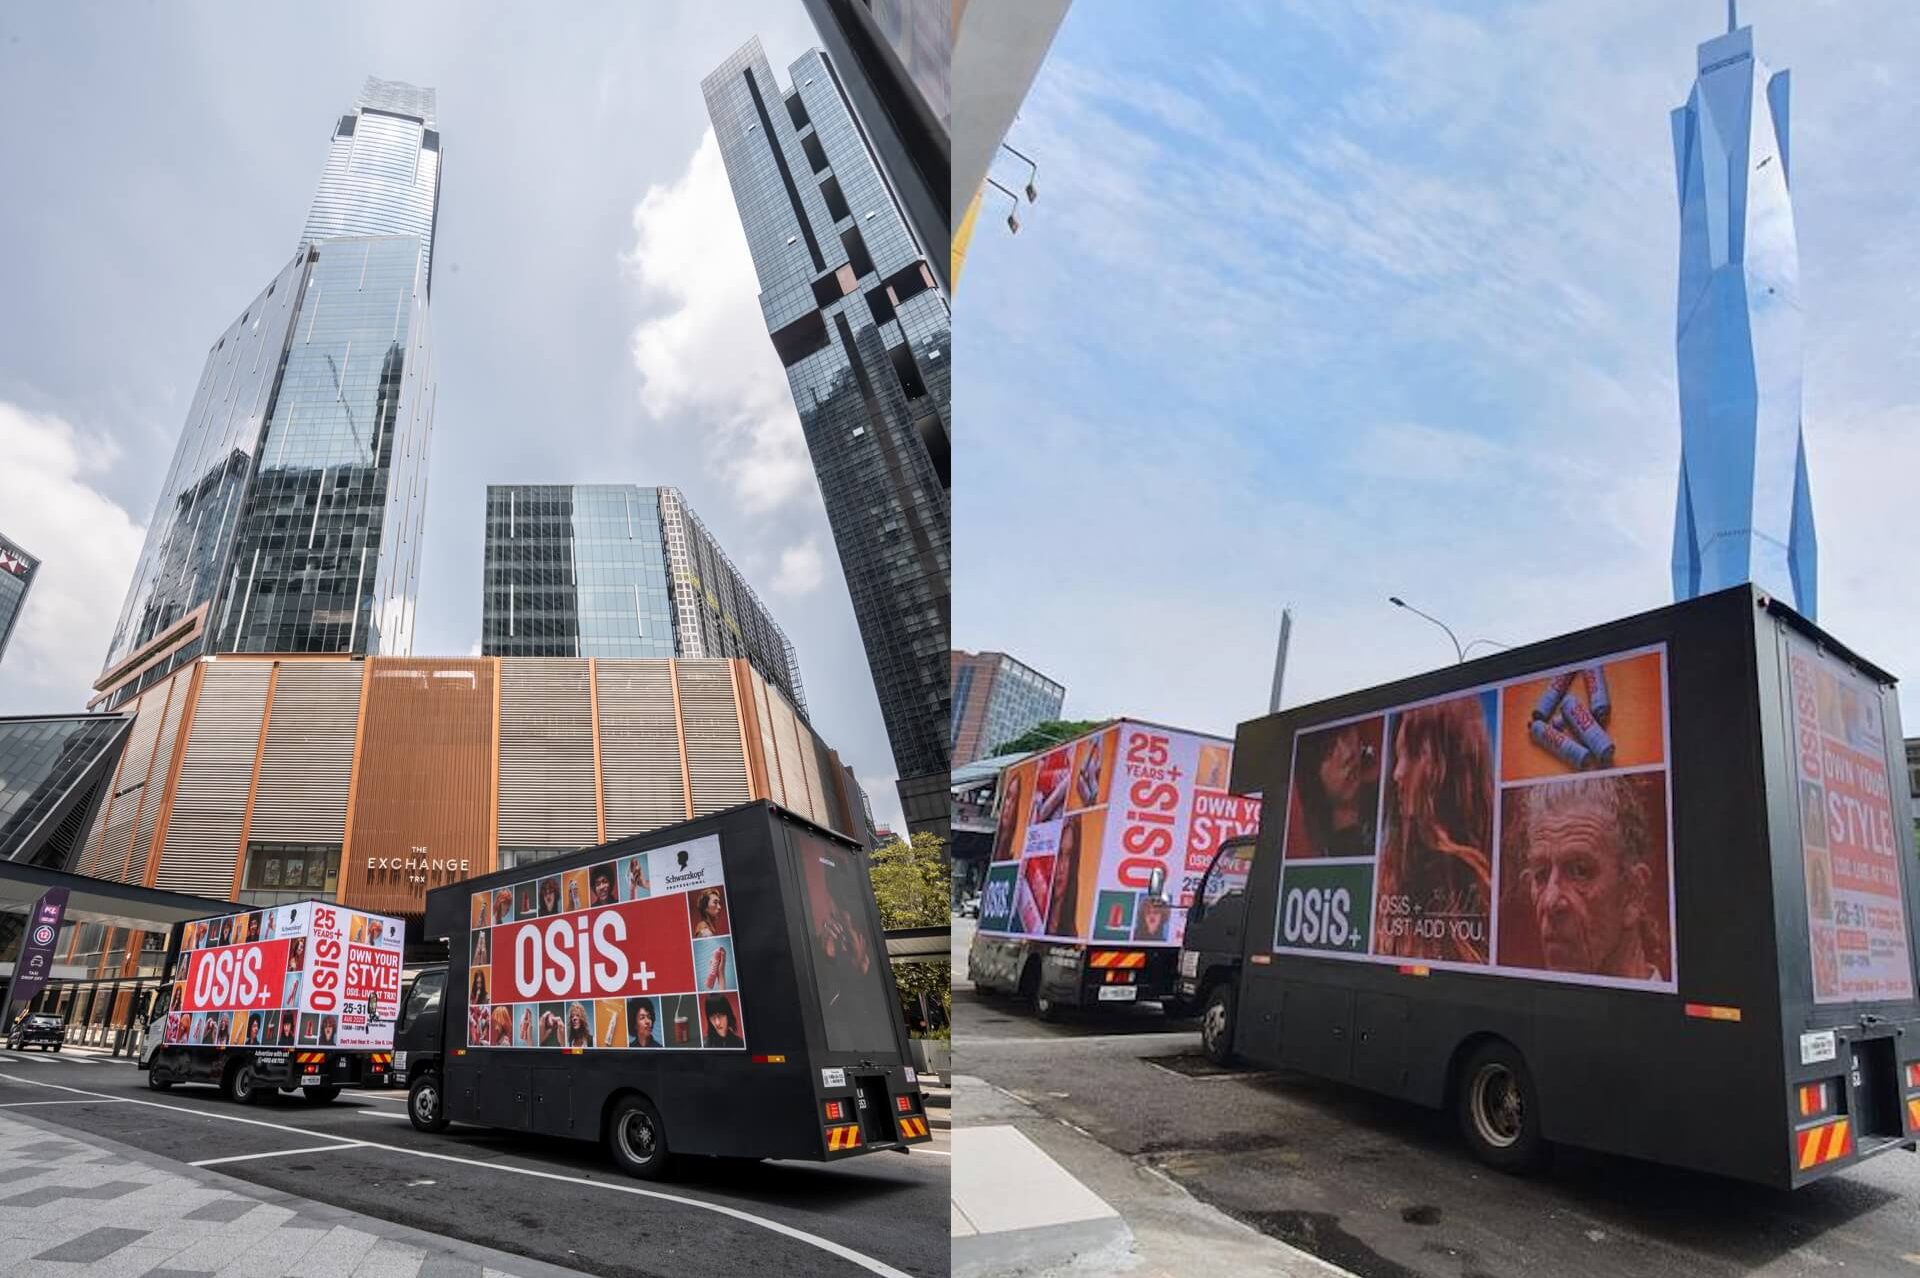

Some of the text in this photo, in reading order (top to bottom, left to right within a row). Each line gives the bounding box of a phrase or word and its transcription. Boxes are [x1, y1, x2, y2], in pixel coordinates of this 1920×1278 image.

[1126, 733, 1170, 767] 25
[1126, 764, 1165, 781] YEARS
[1196, 796, 1237, 818] OWN
[1828, 790, 1894, 857] STYLE
[367, 857, 470, 871] EXCHANGE
[665, 868, 705, 885] Schwarzkopf
[314, 908, 336, 930] 25
[313, 928, 334, 940] YEARS
[1414, 919, 1446, 938] ADD
[1449, 920, 1485, 941] YOU.
[350, 948, 398, 968] OWN YOUR
[347, 962, 398, 990] STYLE
[343, 1003, 366, 1015] 25-31
